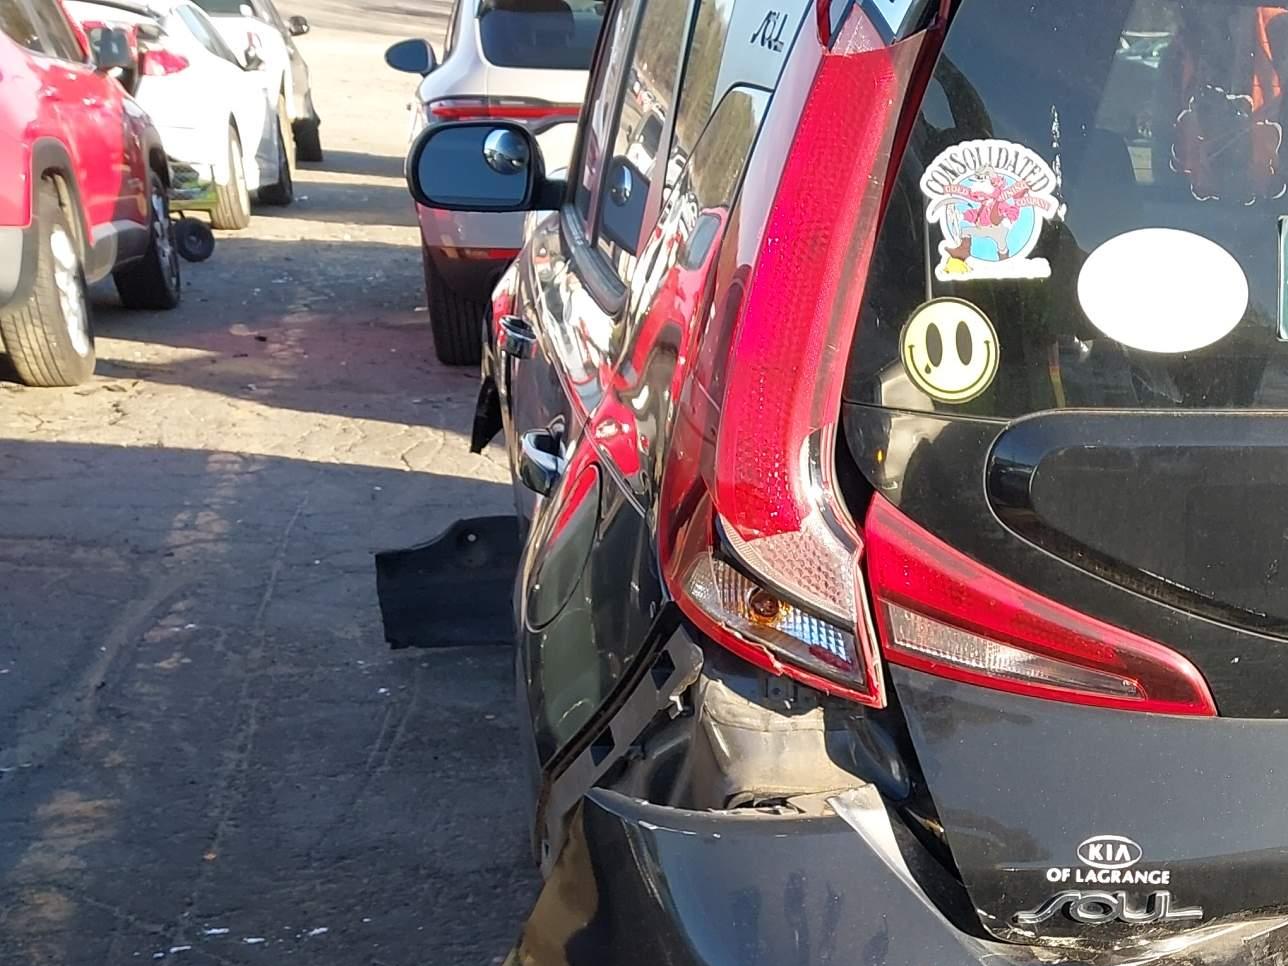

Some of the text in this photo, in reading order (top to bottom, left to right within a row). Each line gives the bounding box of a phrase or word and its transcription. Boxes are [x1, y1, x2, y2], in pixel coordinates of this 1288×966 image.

[926, 146, 1049, 195] CONSOLIDATED
[1088, 843, 1131, 861] KIA
[1046, 868, 1170, 884] OF LAGRANGE
[1012, 889, 1203, 925] SOUL
